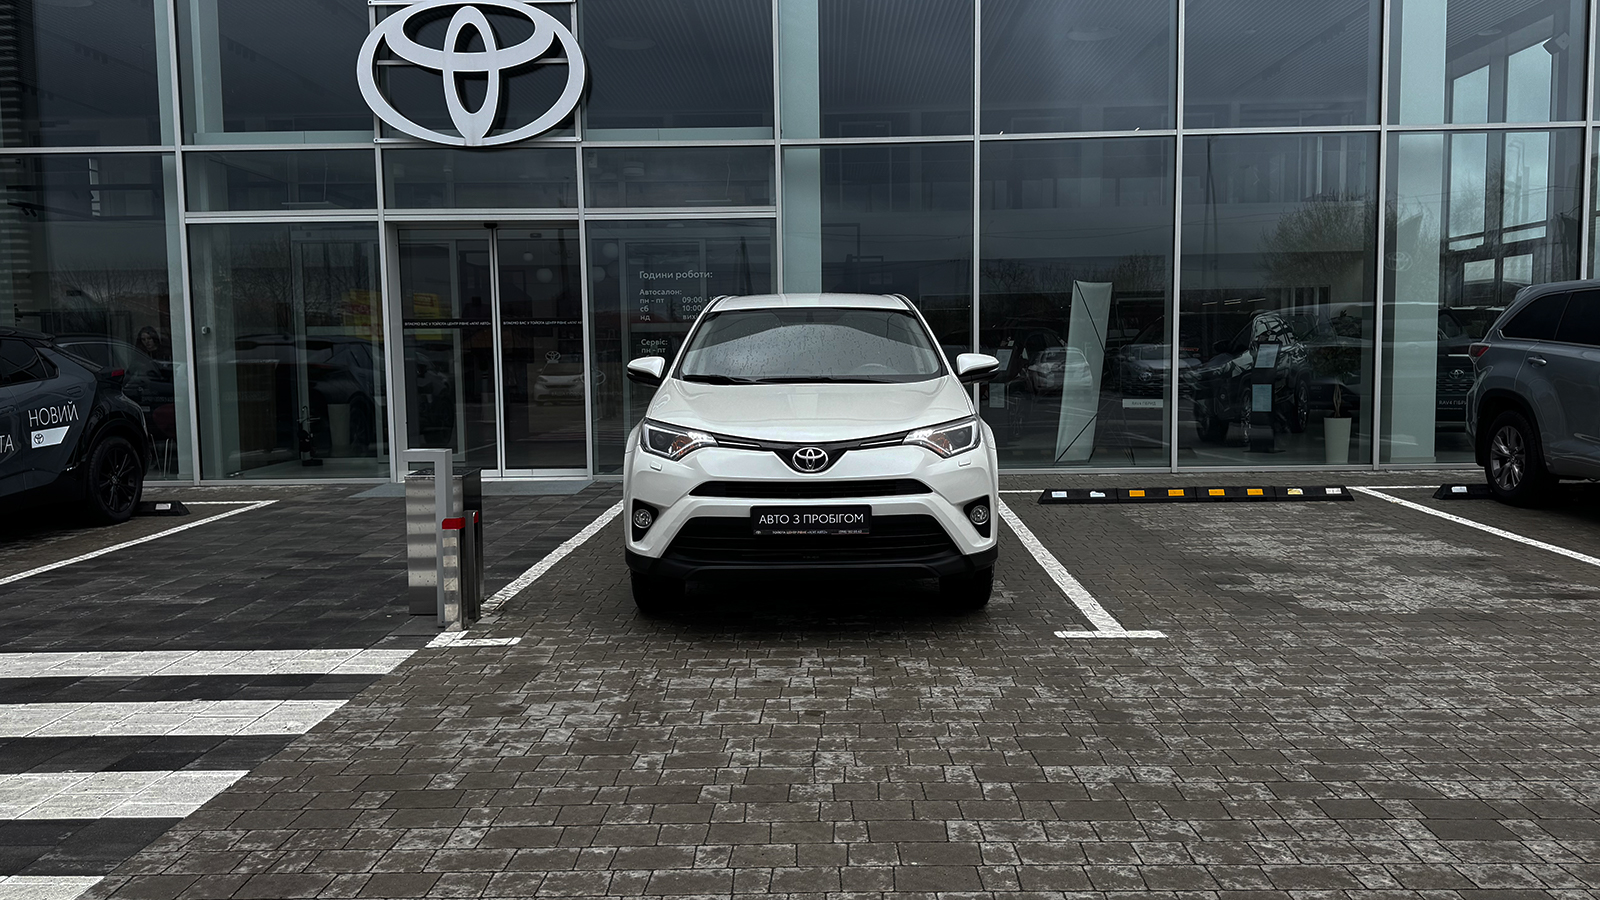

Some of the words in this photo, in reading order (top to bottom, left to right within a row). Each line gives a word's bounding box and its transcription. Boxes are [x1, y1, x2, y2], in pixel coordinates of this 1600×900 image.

[639, 271, 674, 280] Години
[676, 270, 713, 280] роботи:
[28, 401, 79, 427] НОВИЙ
[759, 514, 789, 524] АВТО
[804, 514, 864, 523] ПРОБІГОМ
